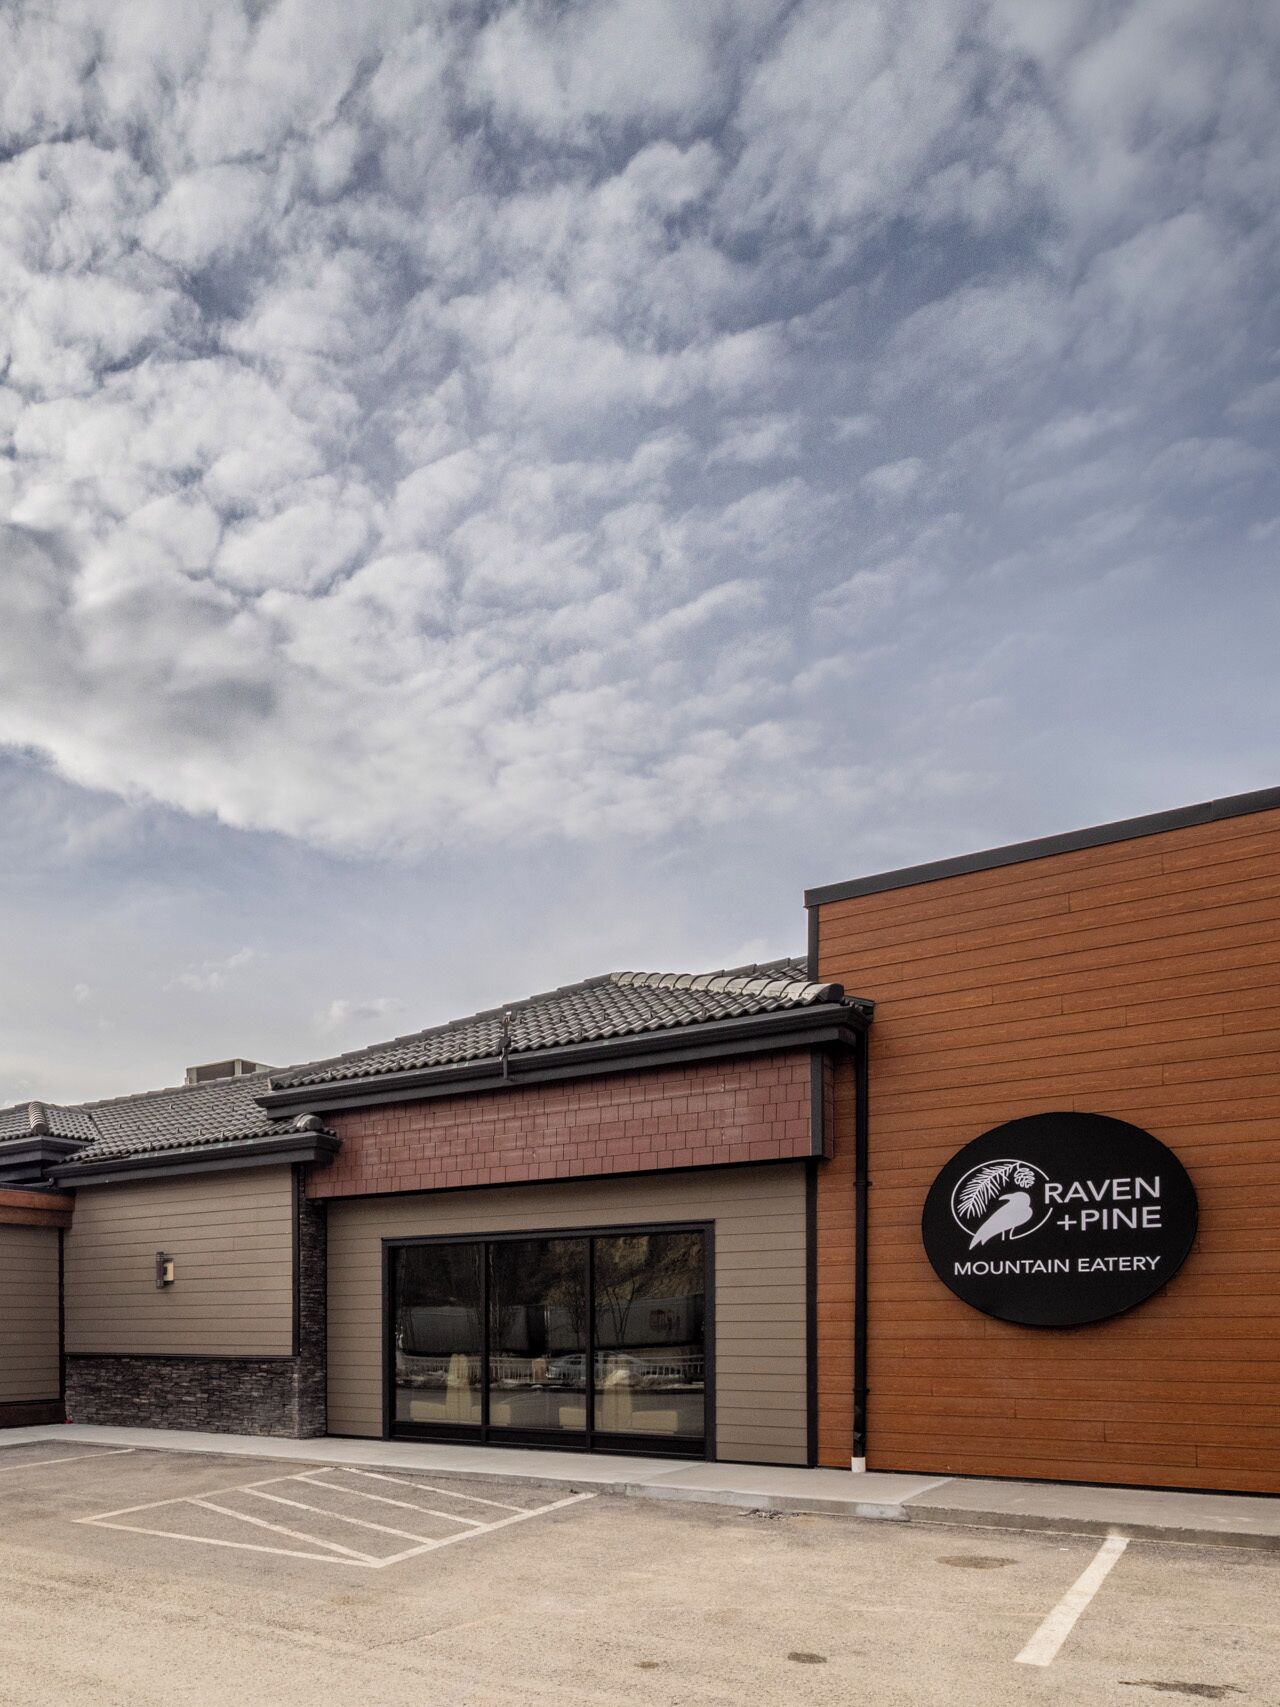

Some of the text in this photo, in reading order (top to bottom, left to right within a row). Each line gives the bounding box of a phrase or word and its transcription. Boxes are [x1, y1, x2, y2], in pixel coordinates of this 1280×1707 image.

[1044, 1176, 1160, 1204] RAVEN
[1056, 1206, 1162, 1231] +PINE
[954, 1256, 1162, 1275] MOUNTAIN EATERY
